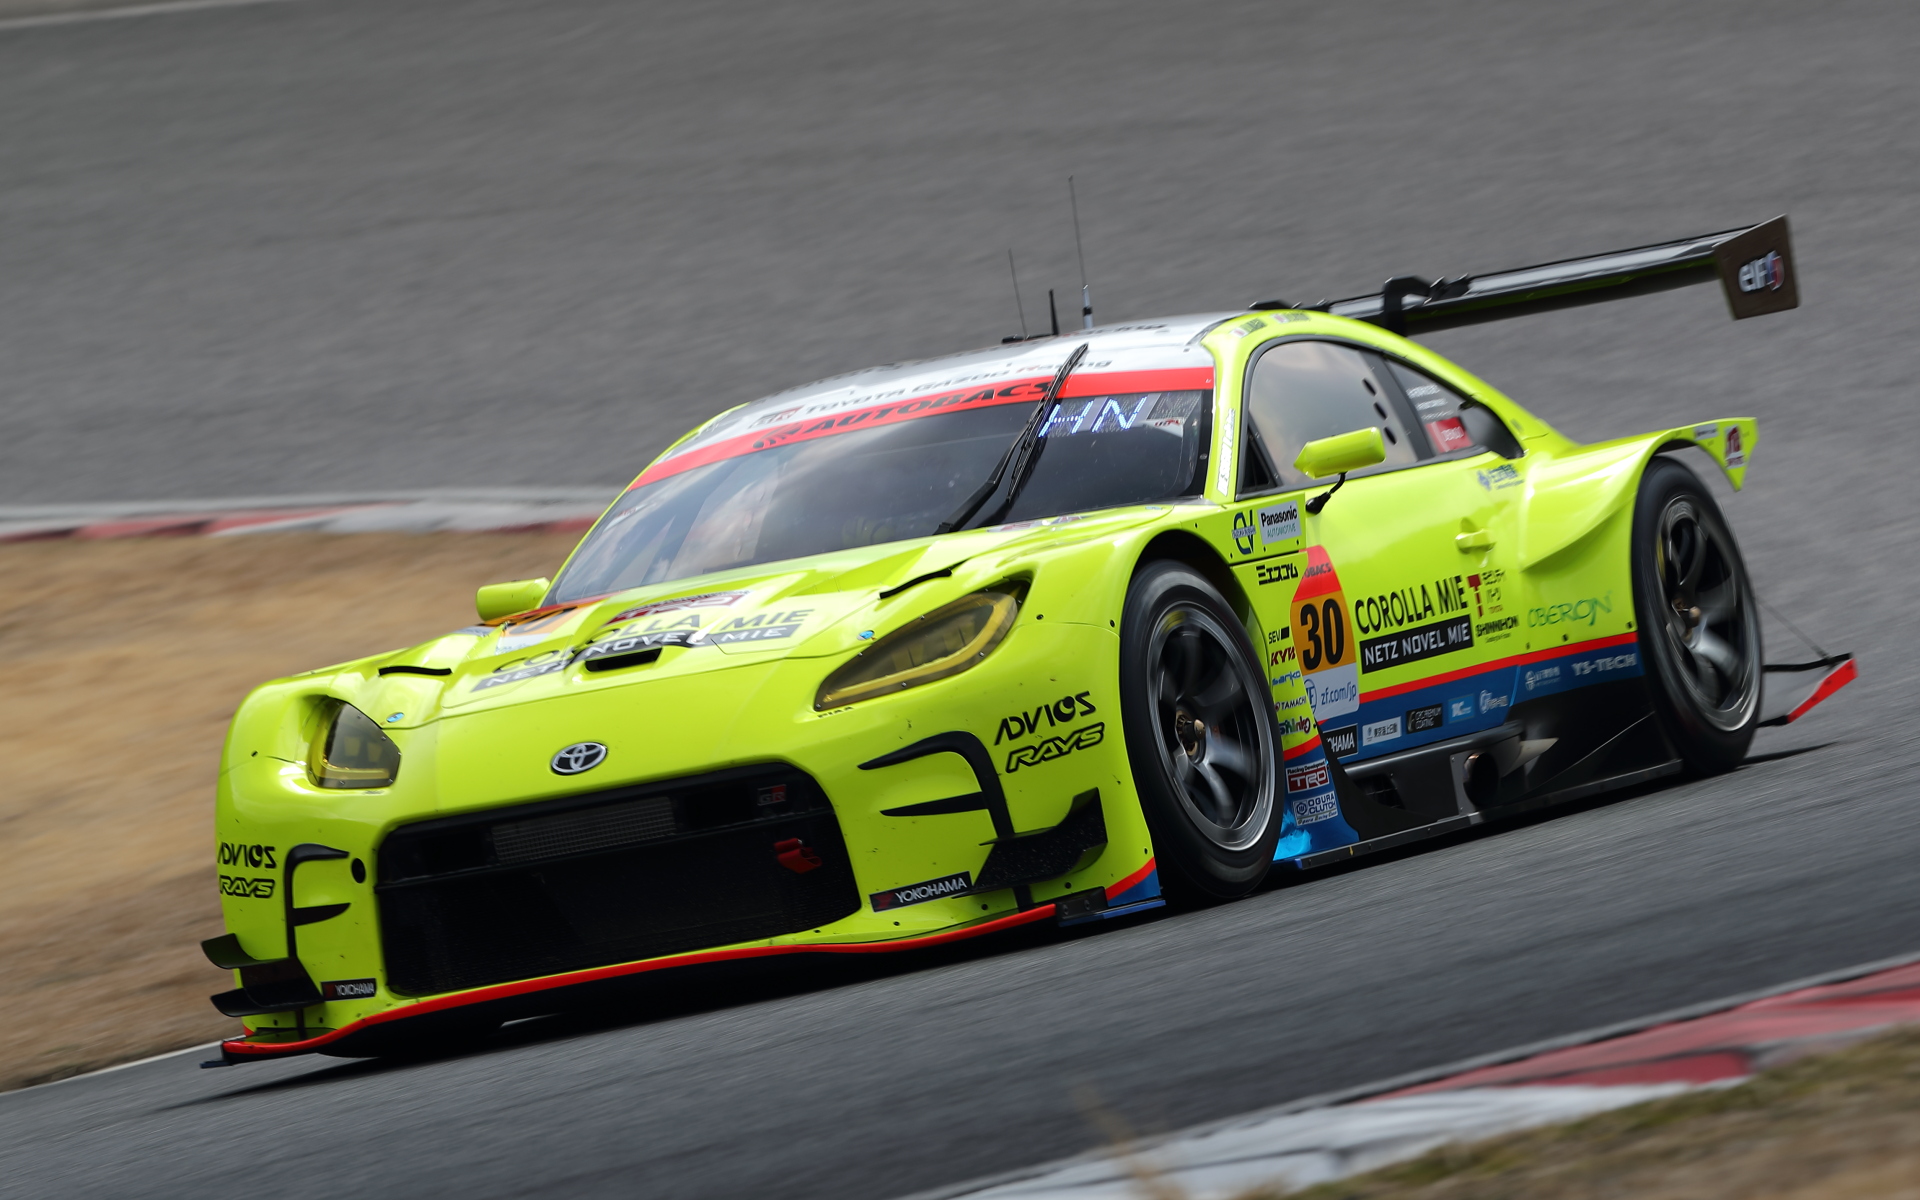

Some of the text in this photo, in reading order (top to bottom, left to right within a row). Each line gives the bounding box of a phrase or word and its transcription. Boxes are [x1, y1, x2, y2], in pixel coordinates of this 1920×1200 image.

[803, 381, 1053, 434] AUTOBACS
[1261, 506, 1298, 528] Panasonic
[1267, 523, 1296, 538] AUTOMOTIVE
[1355, 575, 1468, 634] COROLLA MIE
[721, 608, 815, 631] MIE
[721, 627, 789, 643] MIE
[1300, 598, 1345, 671] 30
[1364, 637, 1399, 667] NETZ
[1402, 629, 1445, 652] NOVEL
[1448, 622, 1471, 644] MIE
[1270, 646, 1296, 667] KYB
[1571, 653, 1637, 676] YS-TECH
[1321, 681, 1357, 705] zf.com/jp
[1005, 721, 1105, 773] RAYS
[1290, 770, 1327, 790] TRD
[1308, 792, 1335, 807] OGURA
[219, 874, 276, 899] RAYS
[895, 877, 968, 904] YOKOHAMA
[335, 982, 375, 996] YOKOHAMA
